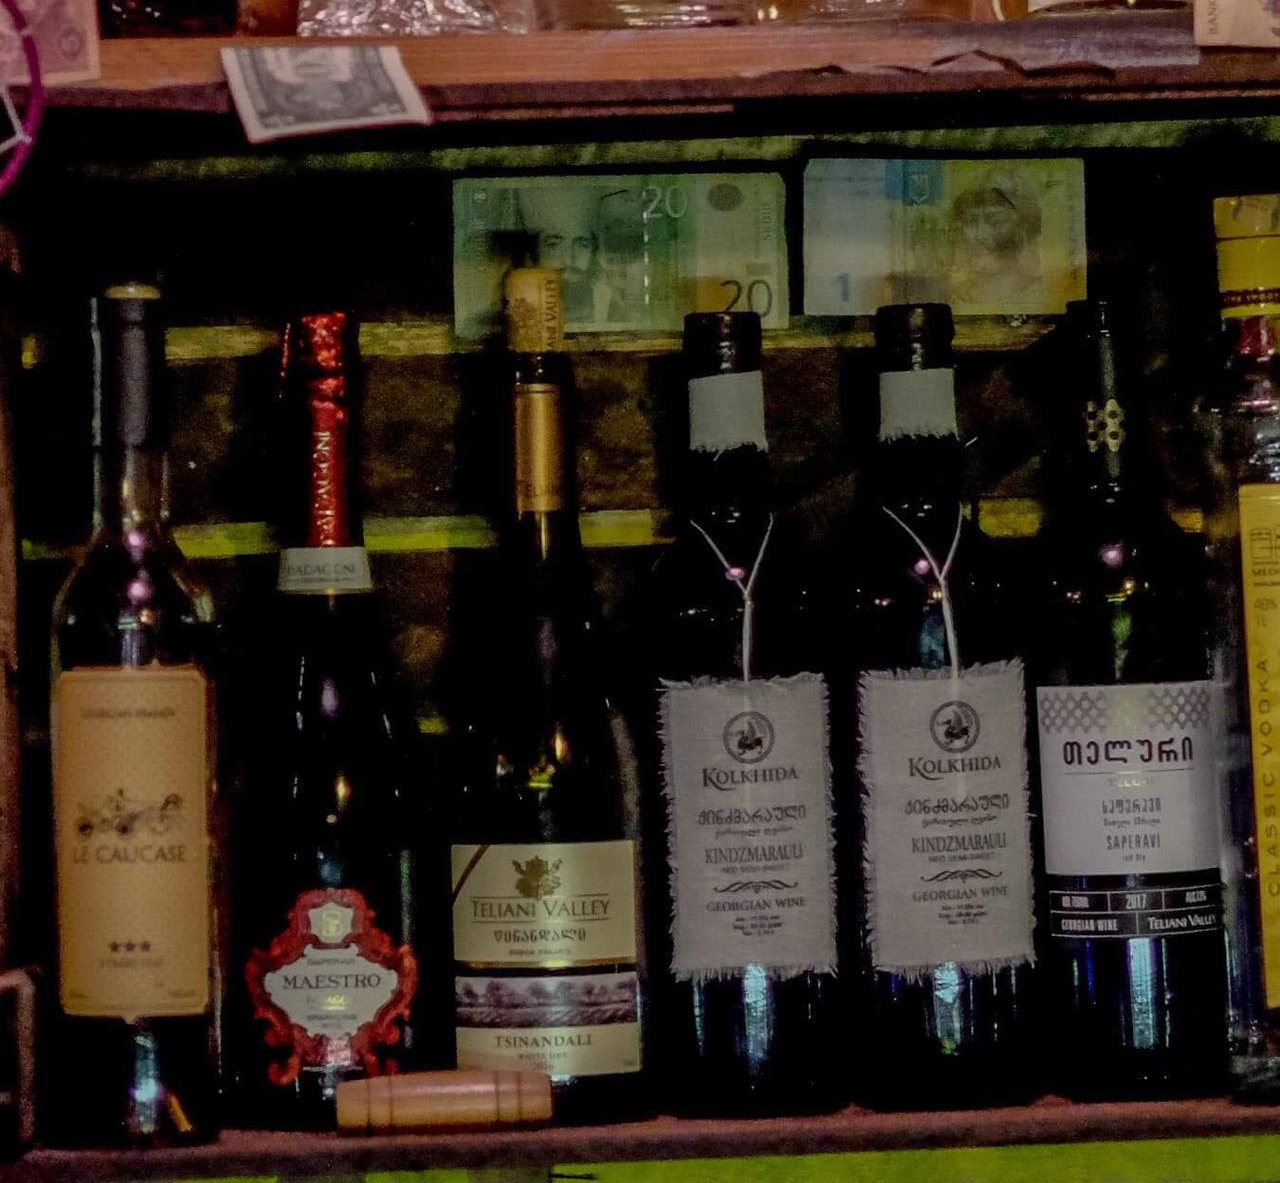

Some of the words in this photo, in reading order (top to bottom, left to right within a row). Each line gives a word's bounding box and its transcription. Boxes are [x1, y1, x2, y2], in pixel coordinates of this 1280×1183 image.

[643, 184, 689, 219] 20
[720, 278, 774, 318] 20
[1257, 656, 1274, 757] VODKA
[1062, 735, 1194, 767] თელური
[701, 766, 800, 792] KOLKHIDA
[907, 755, 1003, 781] KOLKHIDA
[911, 831, 1008, 854] KINDZMARAULI
[1105, 832, 1162, 851] SAPERAVI
[1262, 771, 1280, 898] CLASSIC
[72, 845, 89, 865] LE
[95, 843, 189, 865] CAUCASE
[704, 842, 804, 865] KINDZMARAULI
[706, 898, 772, 913] GEORGIAN
[775, 896, 807, 909] WINE
[911, 887, 978, 903] GEORGIAN
[980, 884, 1010, 898] WINE
[1124, 893, 1148, 910] 2017
[472, 899, 536, 918] TELIANI
[543, 899, 611, 917] VALLEY
[281, 973, 382, 990] MAESTRO
[494, 1033, 593, 1049] TSINANDALI
